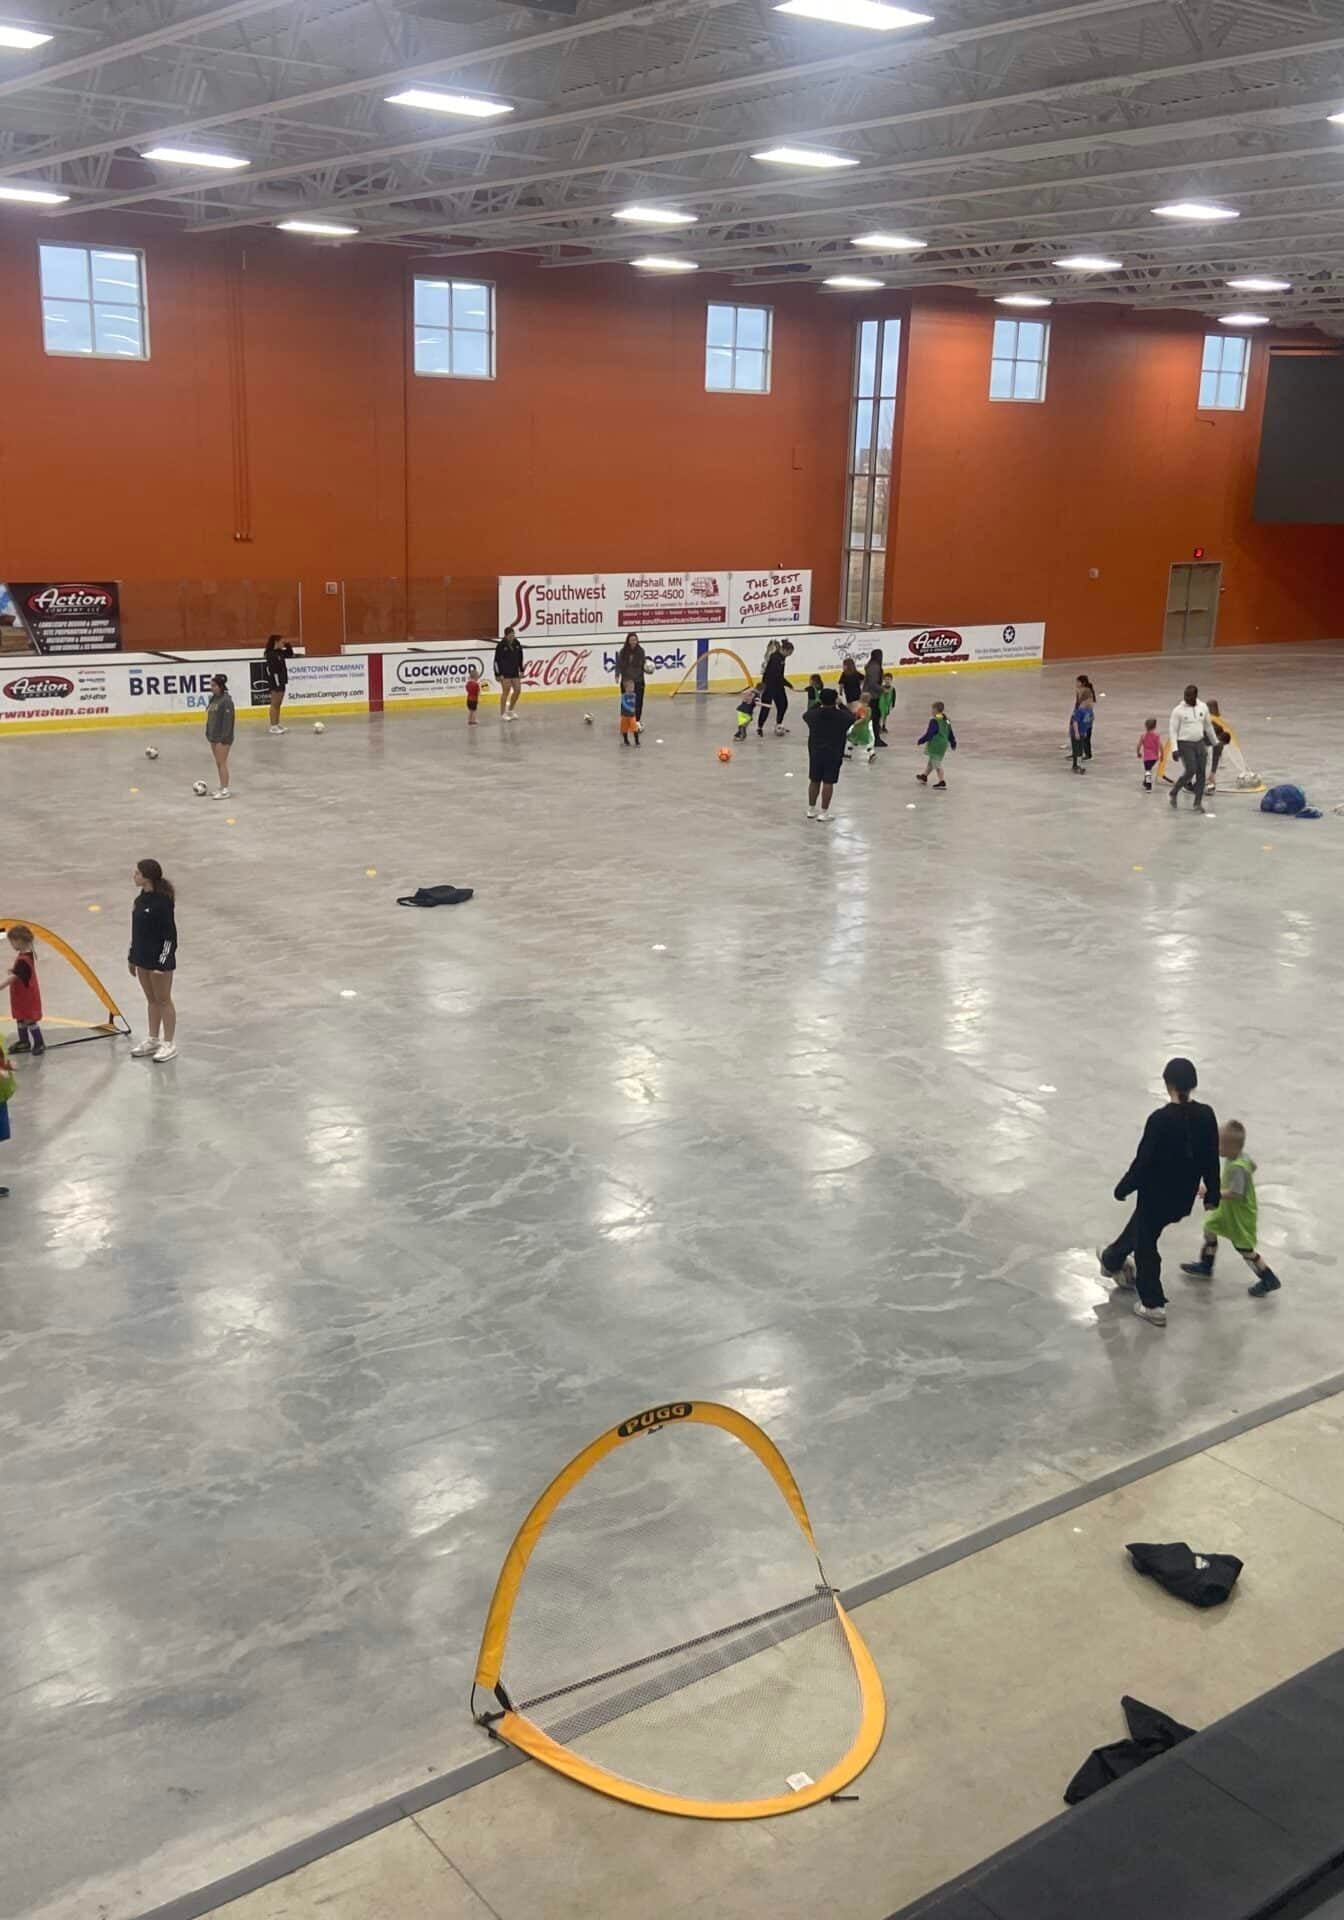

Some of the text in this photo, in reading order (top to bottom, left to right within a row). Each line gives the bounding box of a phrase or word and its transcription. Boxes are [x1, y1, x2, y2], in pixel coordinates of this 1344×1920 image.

[668, 577, 683, 587] MN
[746, 573, 801, 589] THE BEST
[34, 588, 107, 608] Action
[536, 584, 606, 601] Southwest
[624, 589, 685, 601] 507-532-4500
[743, 584, 804, 602] GOALS ARE
[740, 599, 789, 616] GARBAGE
[536, 608, 604, 626] Sanitation
[914, 631, 958, 649] Action
[330, 663, 365, 672] COMPANY
[405, 663, 477, 678] LOCKWOOD
[10, 677, 68, 695] Action
[625, 1404, 685, 1434] PUGG
